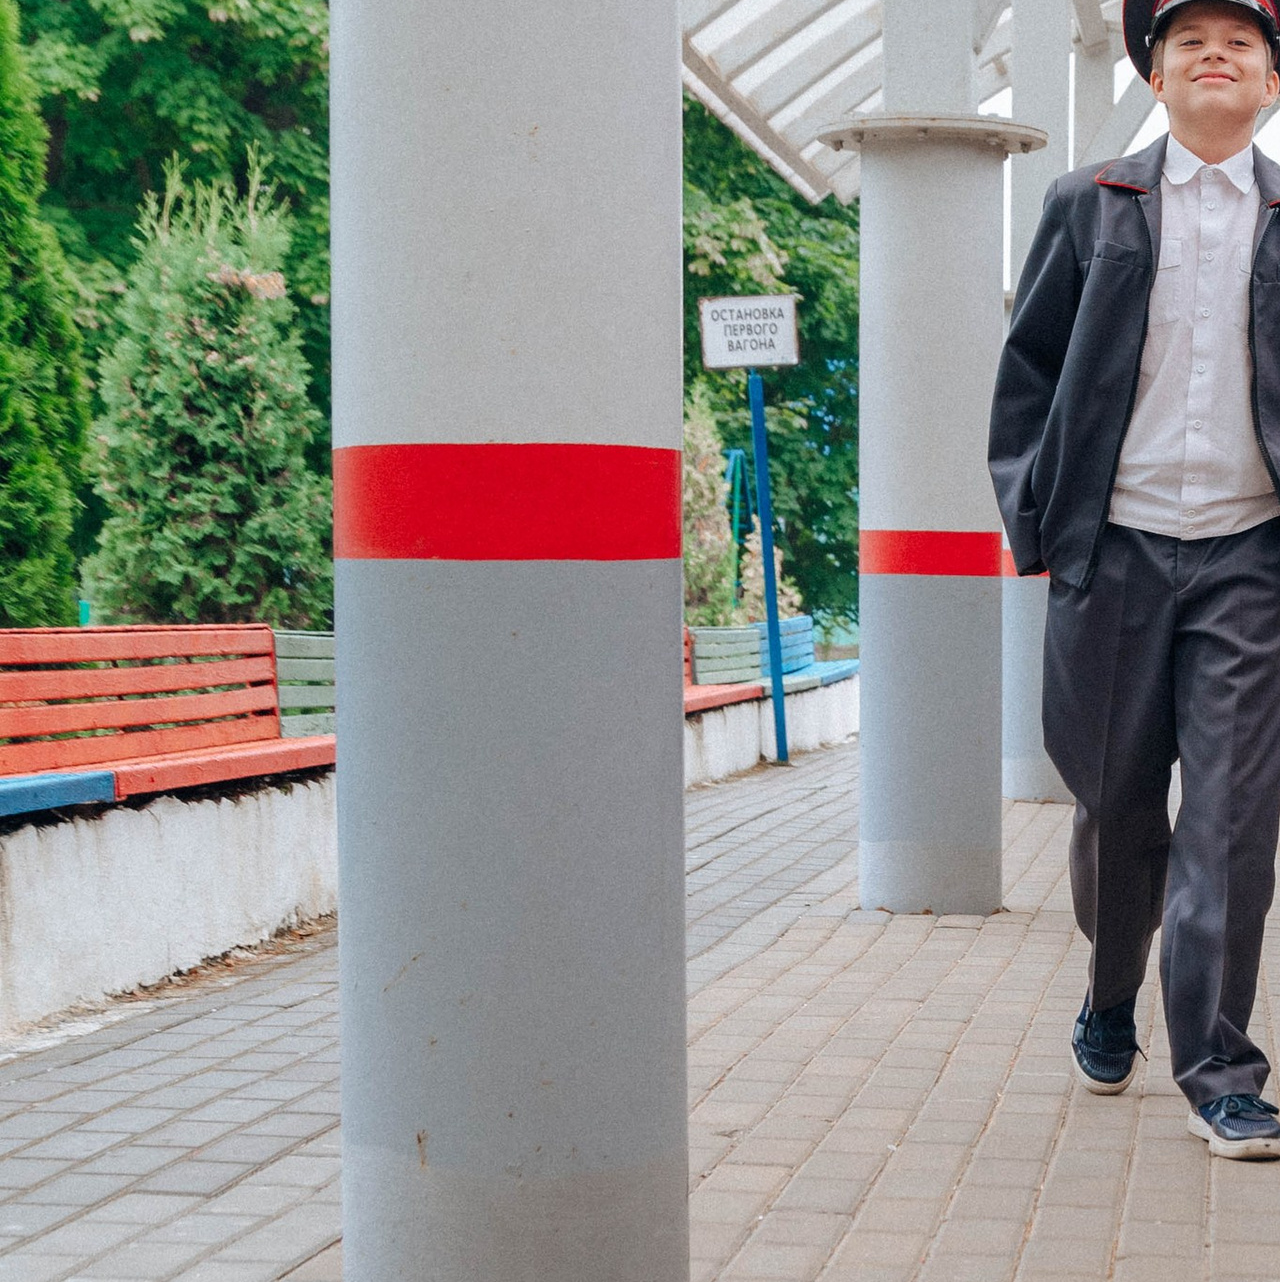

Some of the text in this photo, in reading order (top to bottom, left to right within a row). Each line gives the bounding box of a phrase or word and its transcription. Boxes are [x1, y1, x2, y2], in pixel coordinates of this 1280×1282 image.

[710, 307, 785, 322] ОСТАНОВКА
[723, 322, 778, 337] ПЕРВОГО
[727, 338, 776, 352] ВАГОНА
